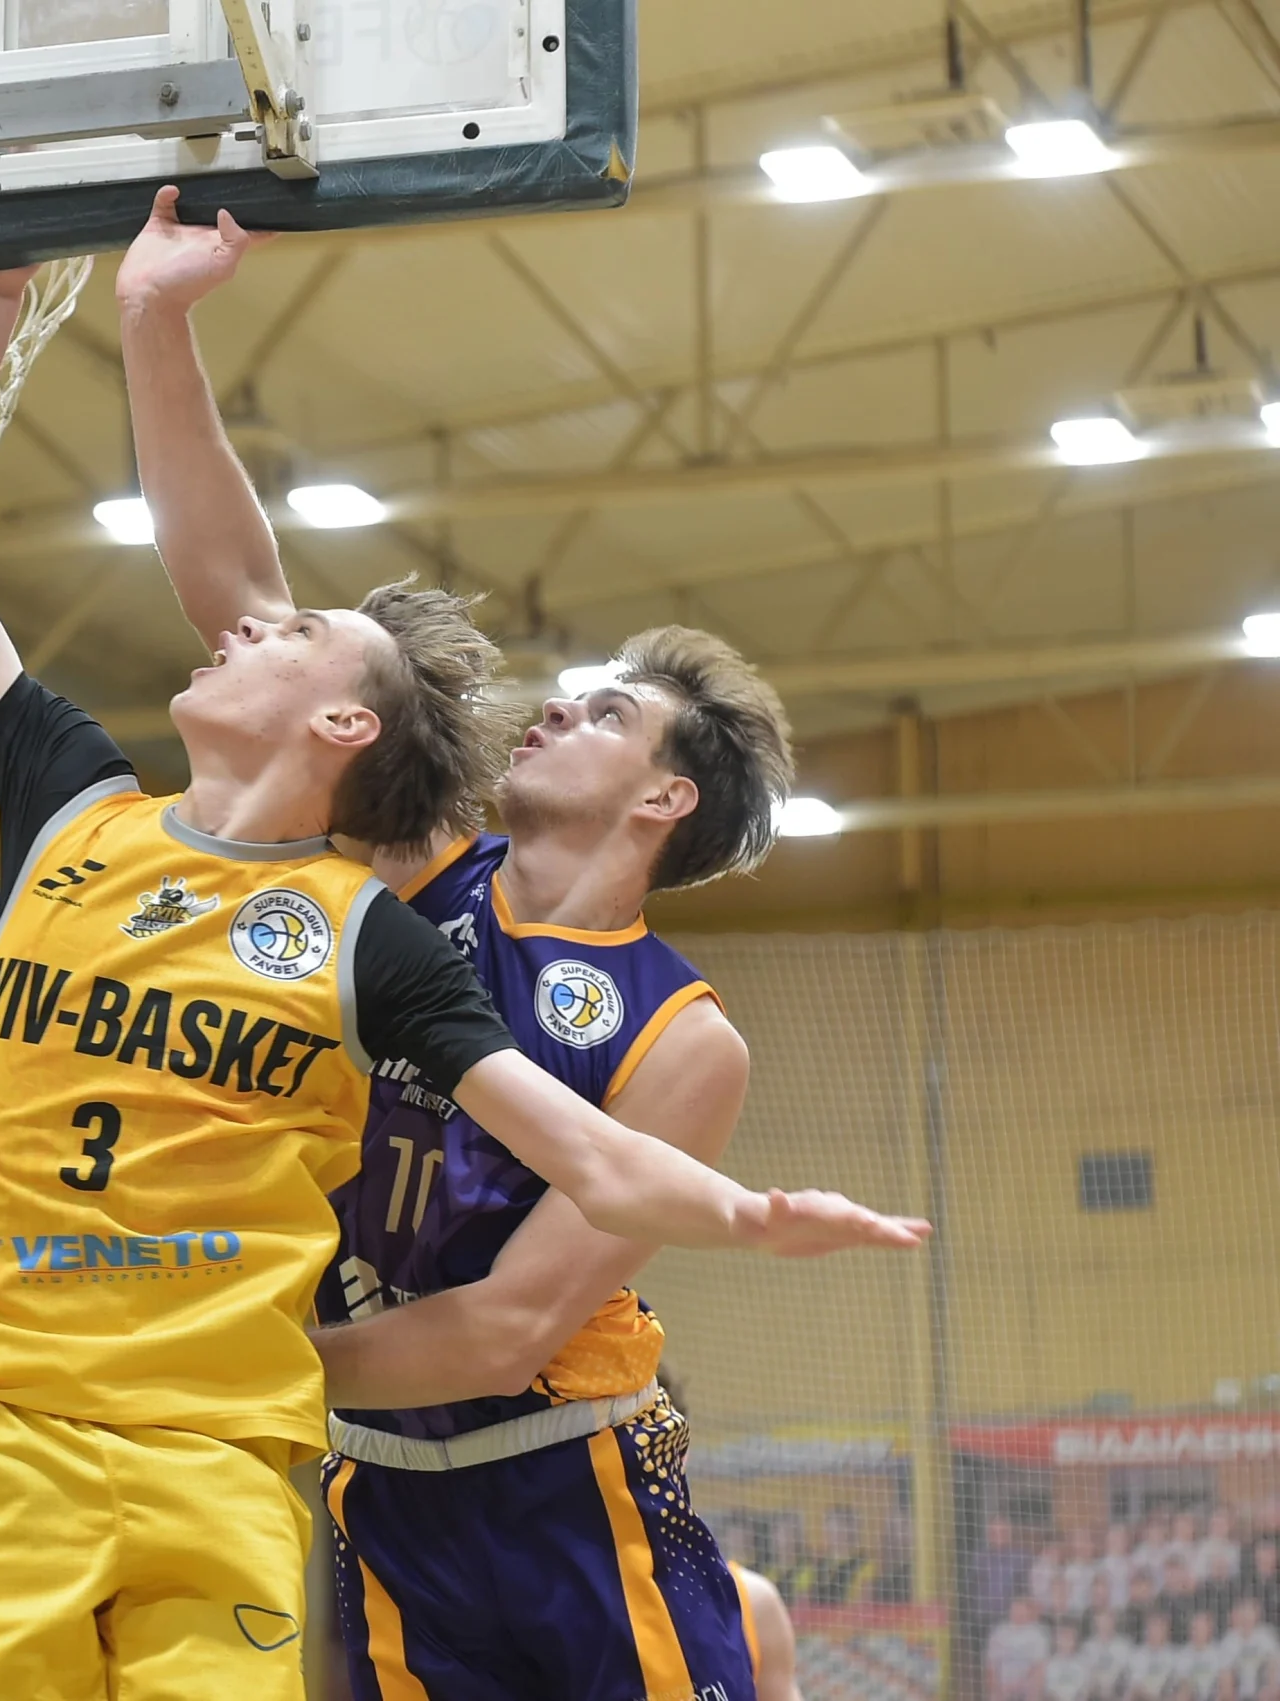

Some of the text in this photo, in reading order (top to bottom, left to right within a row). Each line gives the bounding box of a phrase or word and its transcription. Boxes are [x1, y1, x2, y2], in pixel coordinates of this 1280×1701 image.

[254, 896, 324, 937] SUPERLEAGUE
[249, 954, 299, 975] FAVBET
[560, 965, 615, 1015] SUPERLEAGUE
[546, 1013, 585, 1041] FAVBET
[59, 1101, 122, 1192] 3
[10, 1230, 241, 1271] VENETO
